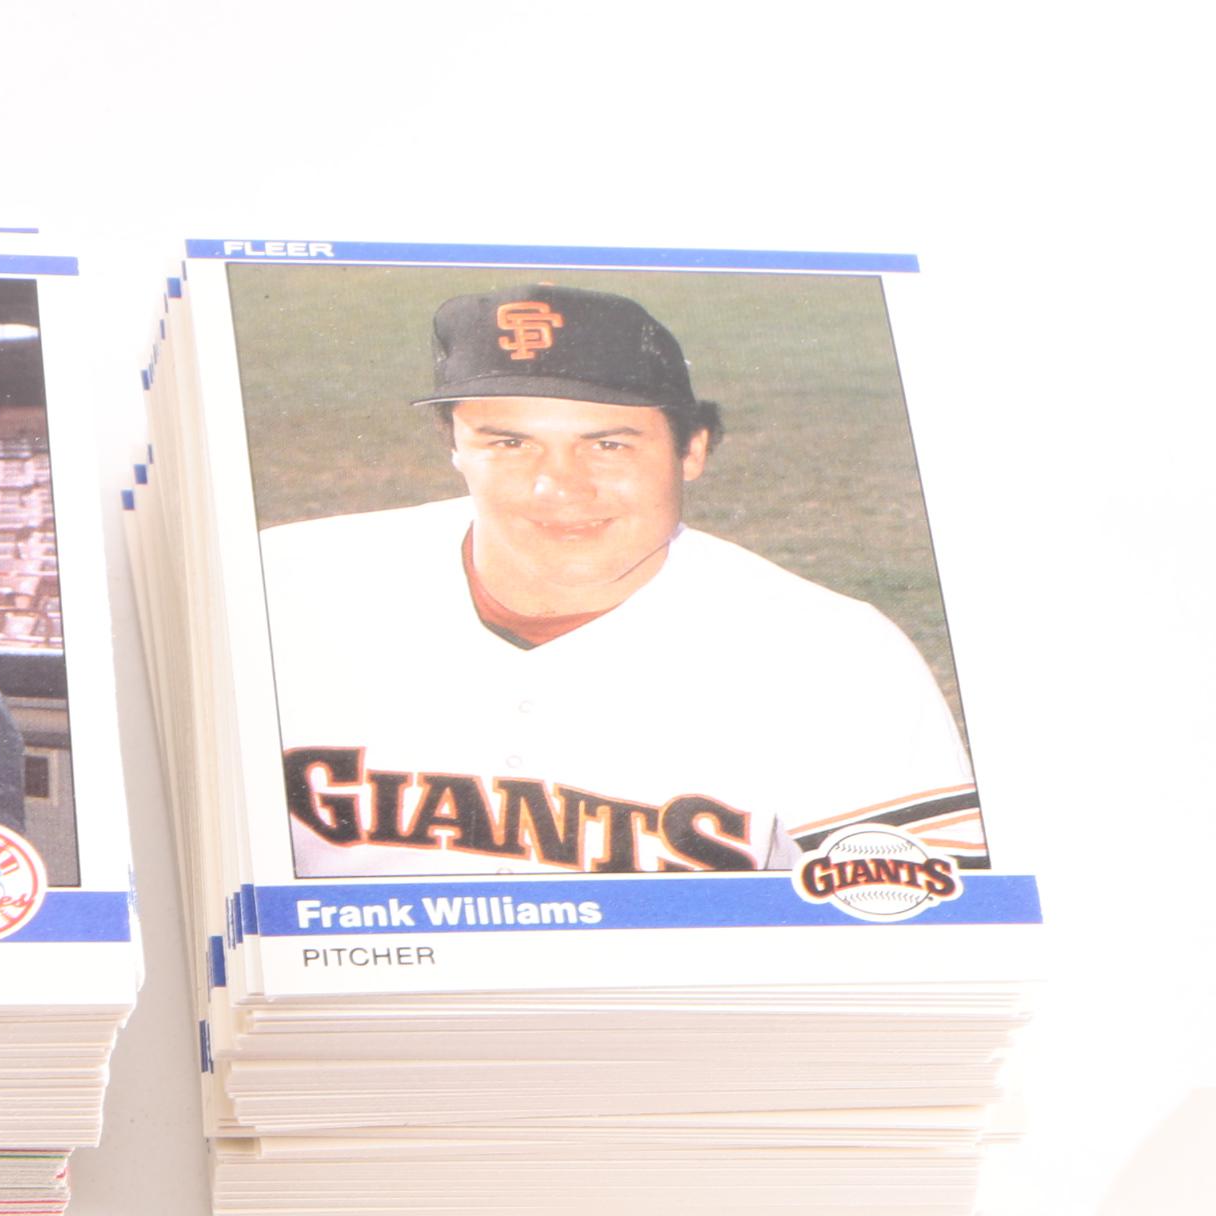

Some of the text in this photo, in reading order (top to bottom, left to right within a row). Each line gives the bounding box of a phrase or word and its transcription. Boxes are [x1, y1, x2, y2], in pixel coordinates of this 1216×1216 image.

[224, 240, 334, 258] FLEER
[284, 746, 753, 871] GIANTS
[801, 856, 957, 899] GIANTS
[296, 897, 602, 929] Frank Williams
[302, 947, 436, 967] PITCHER
